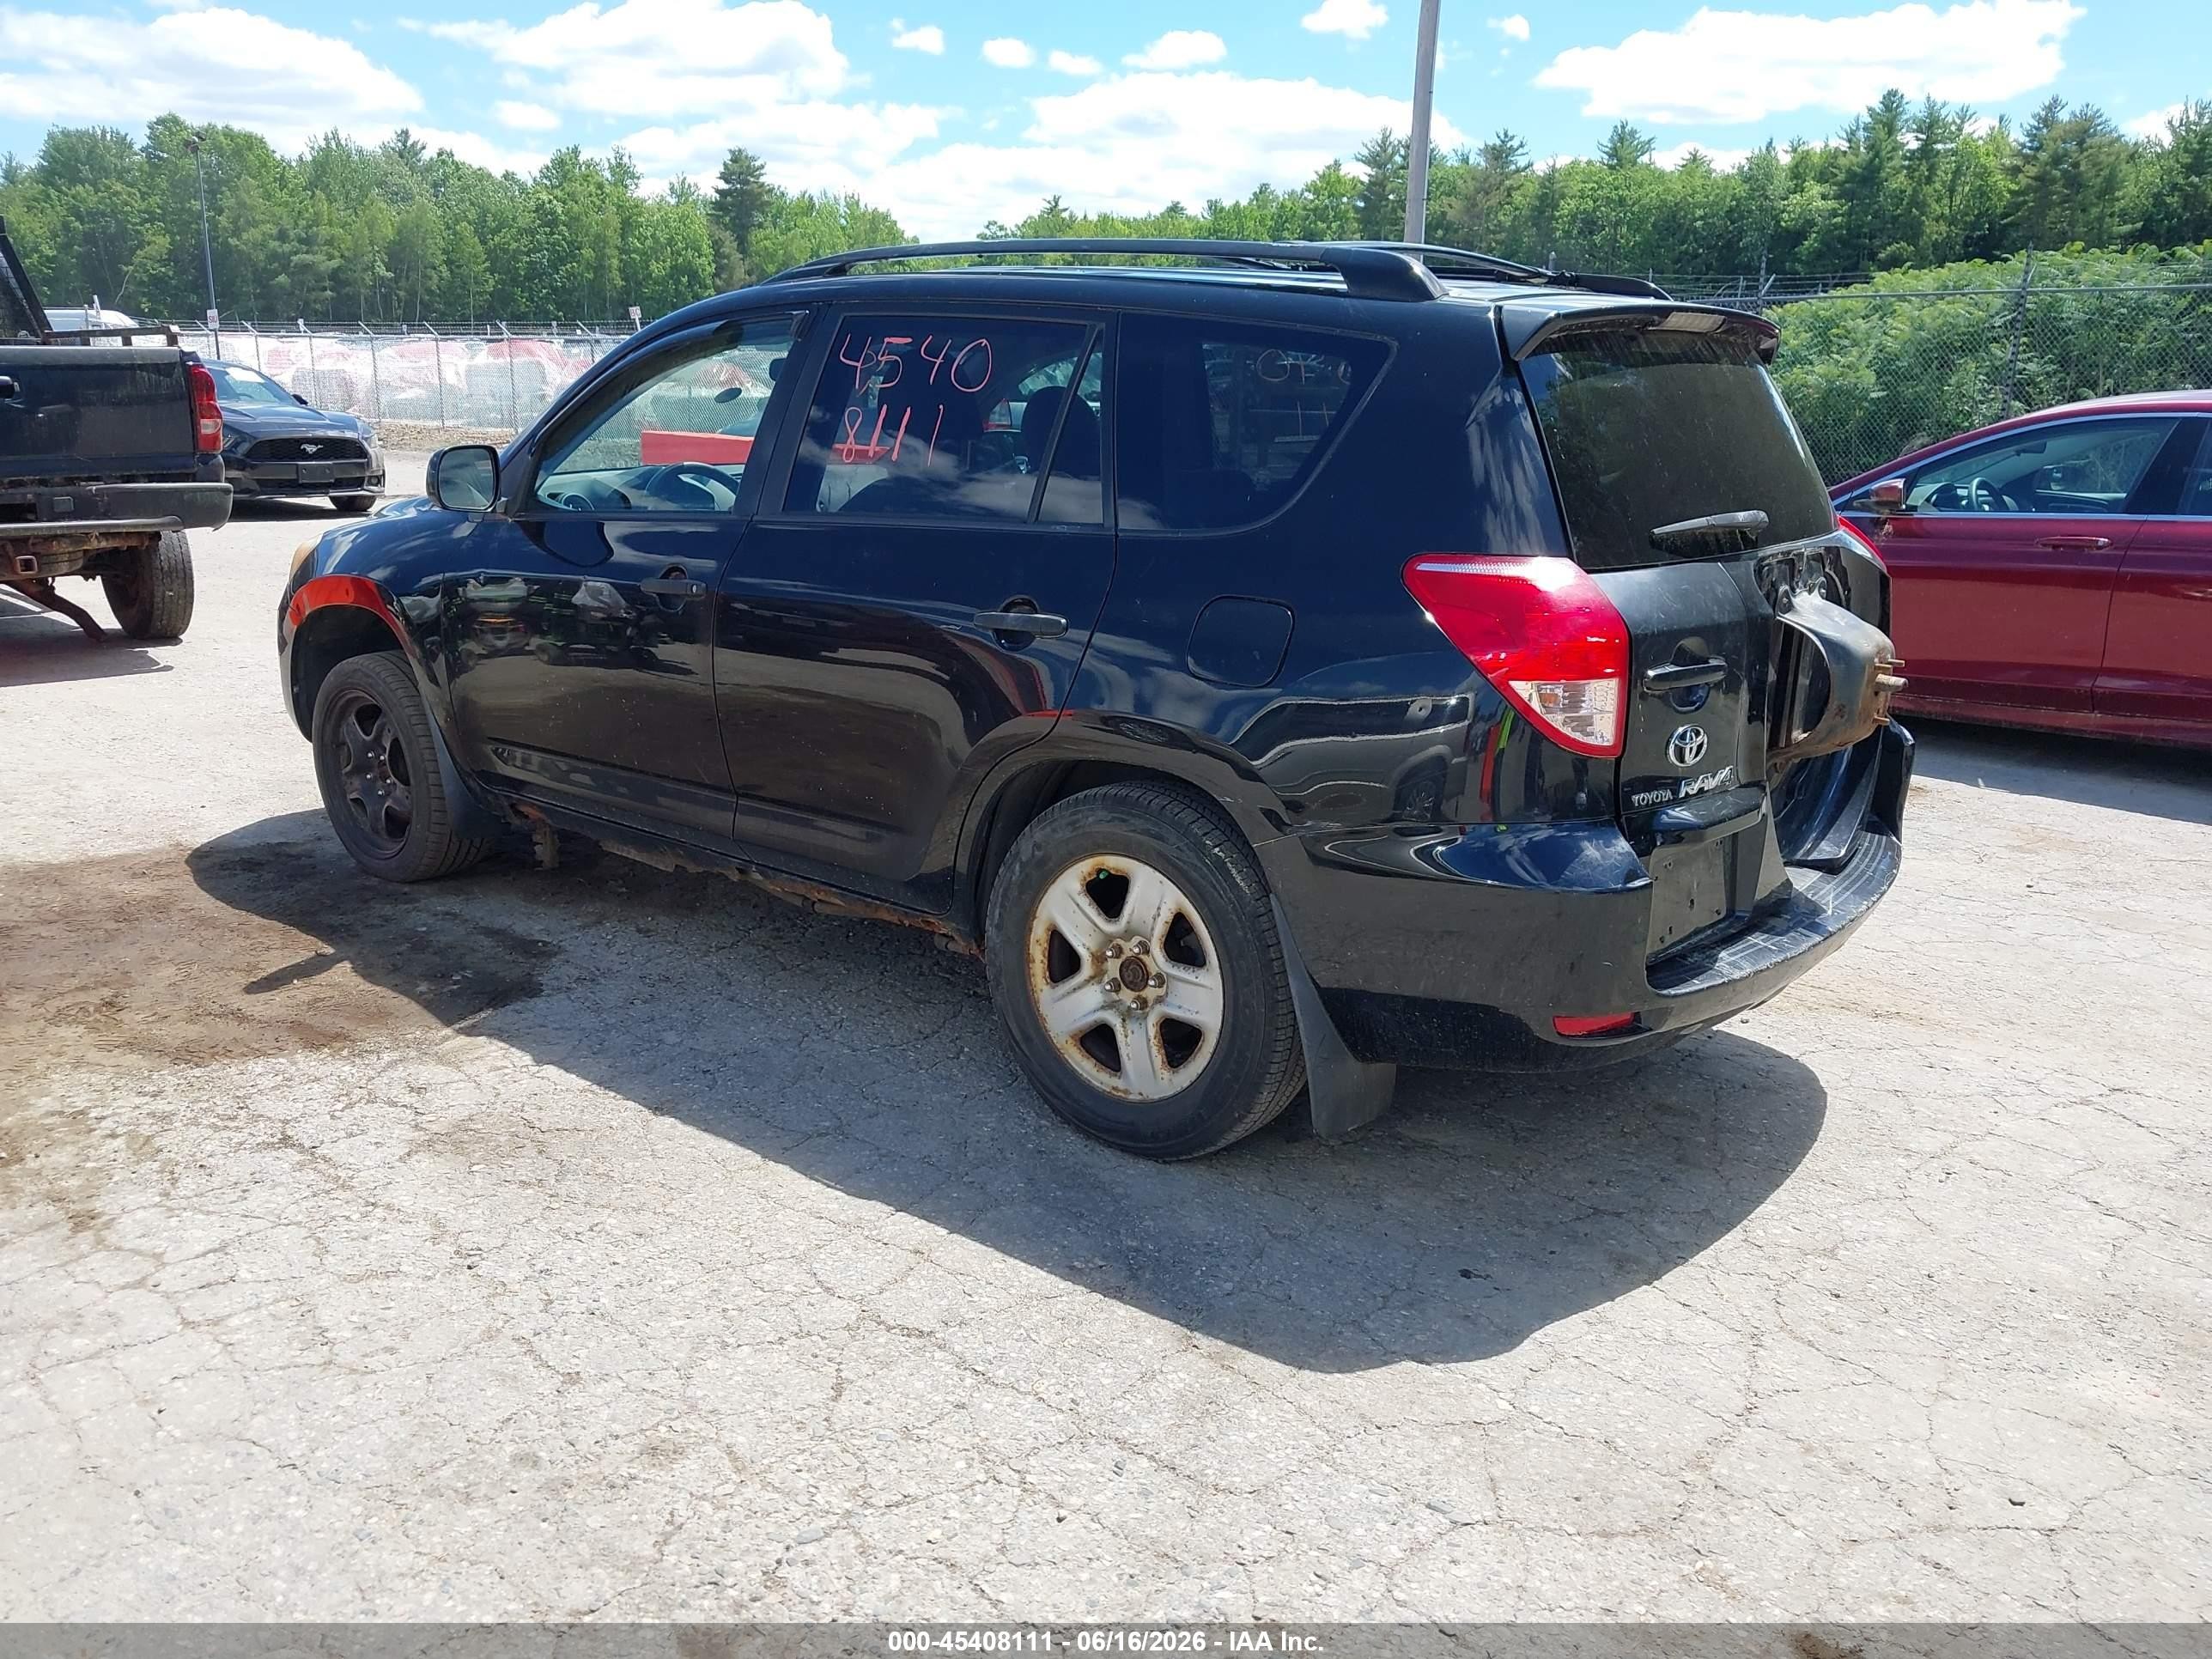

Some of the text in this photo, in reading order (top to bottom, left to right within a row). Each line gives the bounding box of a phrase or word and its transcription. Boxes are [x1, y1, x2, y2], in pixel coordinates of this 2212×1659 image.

[839, 332, 992, 392] 4540
[1632, 765, 1734, 807] TOYOTA RAV4
